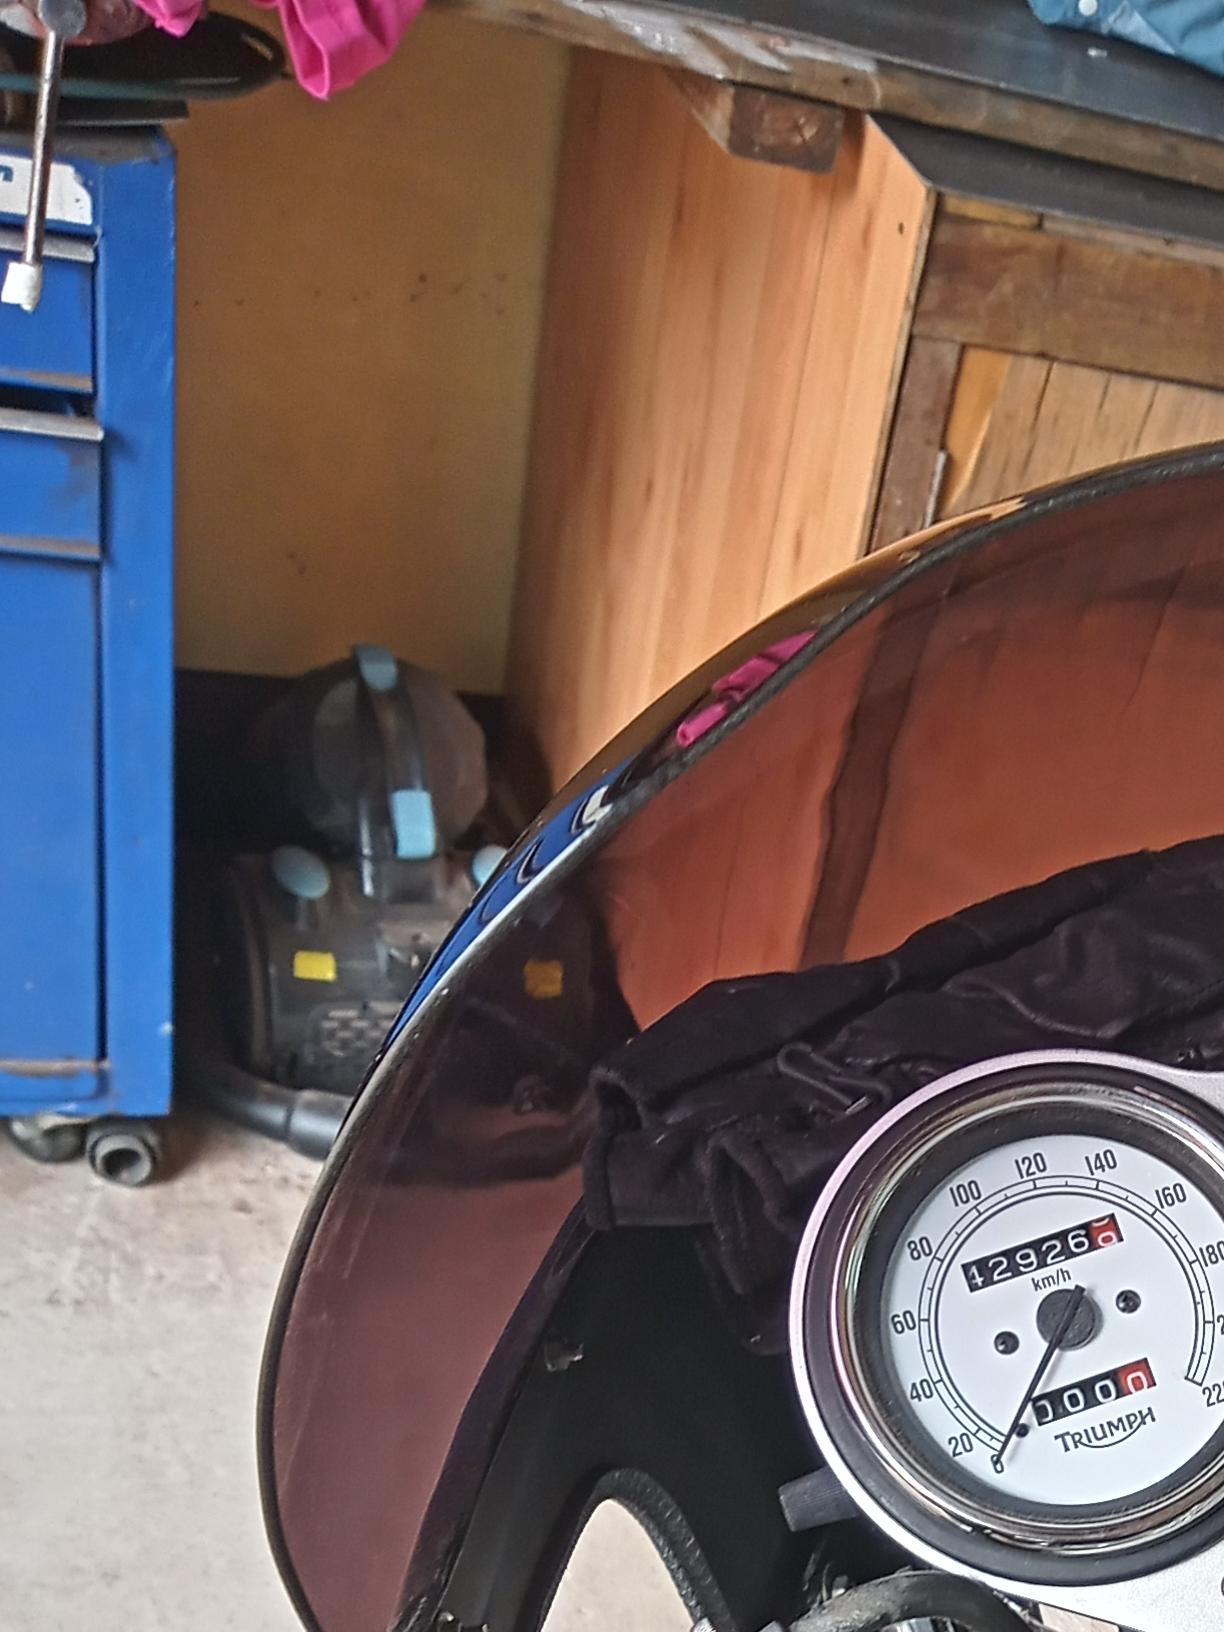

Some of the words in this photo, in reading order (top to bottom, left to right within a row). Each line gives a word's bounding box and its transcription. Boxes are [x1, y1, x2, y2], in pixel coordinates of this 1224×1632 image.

[1015, 1152, 1047, 1178] 120
[1085, 1149, 1118, 1175] 140
[949, 1180, 982, 1208] 100
[1154, 1183, 1187, 1210] 160
[908, 1236, 933, 1261] 80
[1031, 1268, 1072, 1292] km/h
[891, 1311, 917, 1334] 60
[908, 1379, 934, 1403] 40
[1054, 1407, 1156, 1453] TRIUMPH
[948, 1433, 974, 1458] 20
